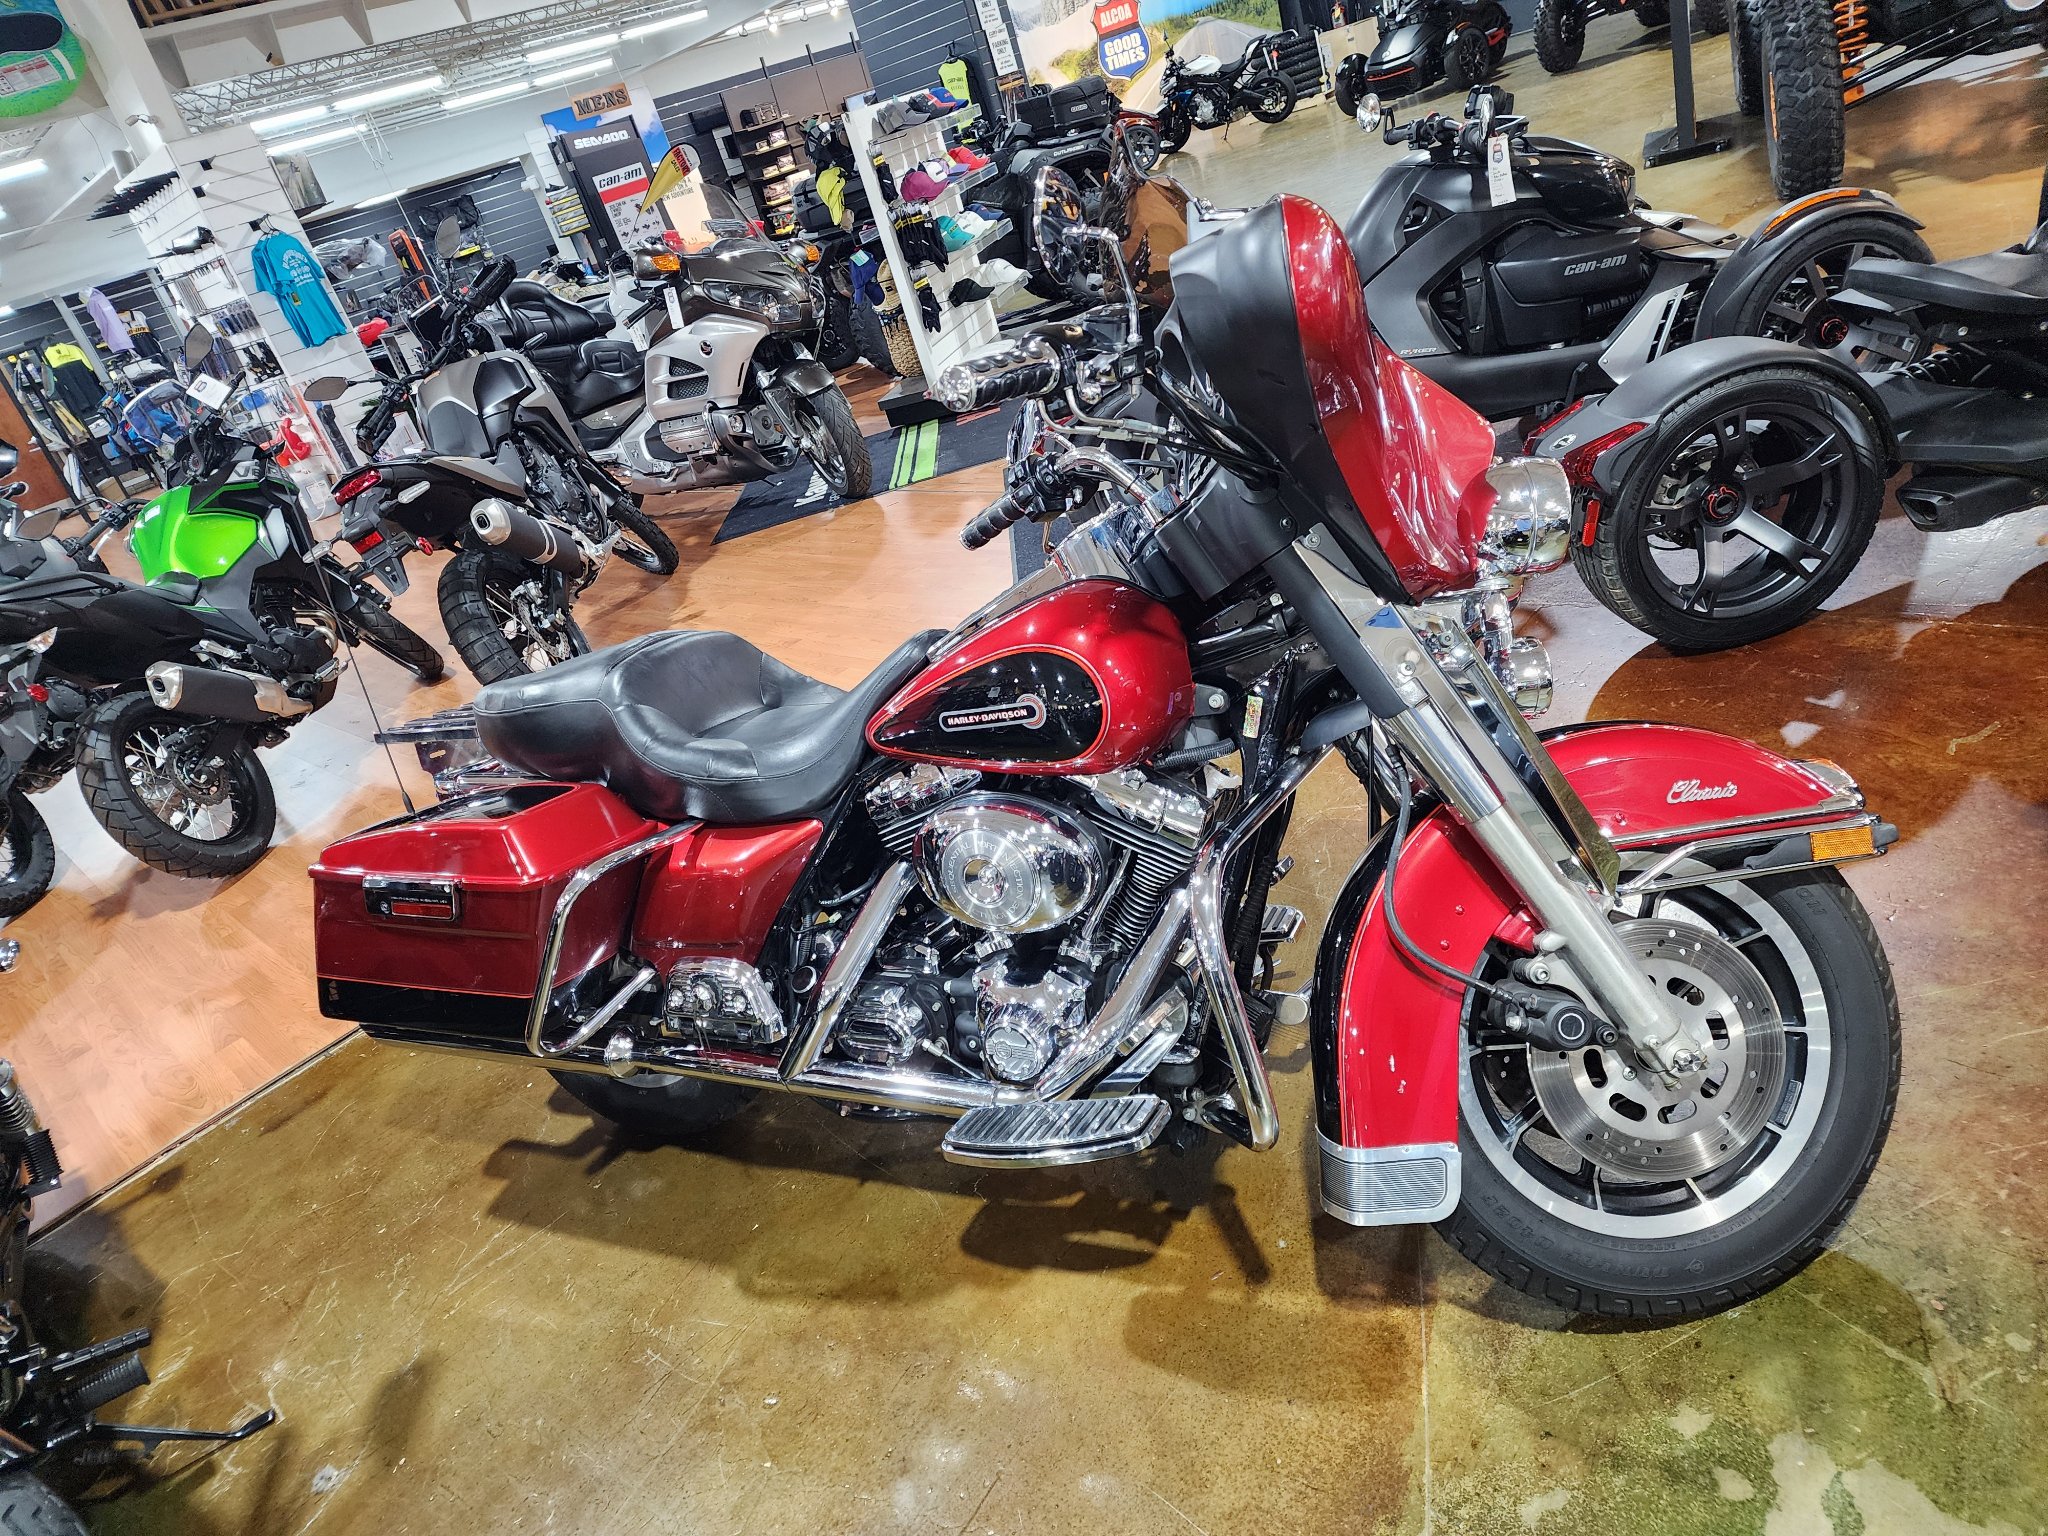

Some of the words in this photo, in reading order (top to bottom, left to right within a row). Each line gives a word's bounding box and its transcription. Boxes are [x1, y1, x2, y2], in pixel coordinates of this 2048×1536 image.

[1100, 3, 1133, 28] ALCOA
[1104, 33, 1142, 56] GOOD
[1105, 46, 1147, 70] TIMES
[574, 88, 629, 116] MENS
[672, 147, 691, 176] FACTORY
[1053, 145, 1085, 156] OUTLANDER
[599, 167, 642, 189] can-am
[1564, 254, 1628, 275] can-am
[947, 708, 1027, 726] HARLEY-DAVIDSON
[1666, 779, 1738, 804] Classic
